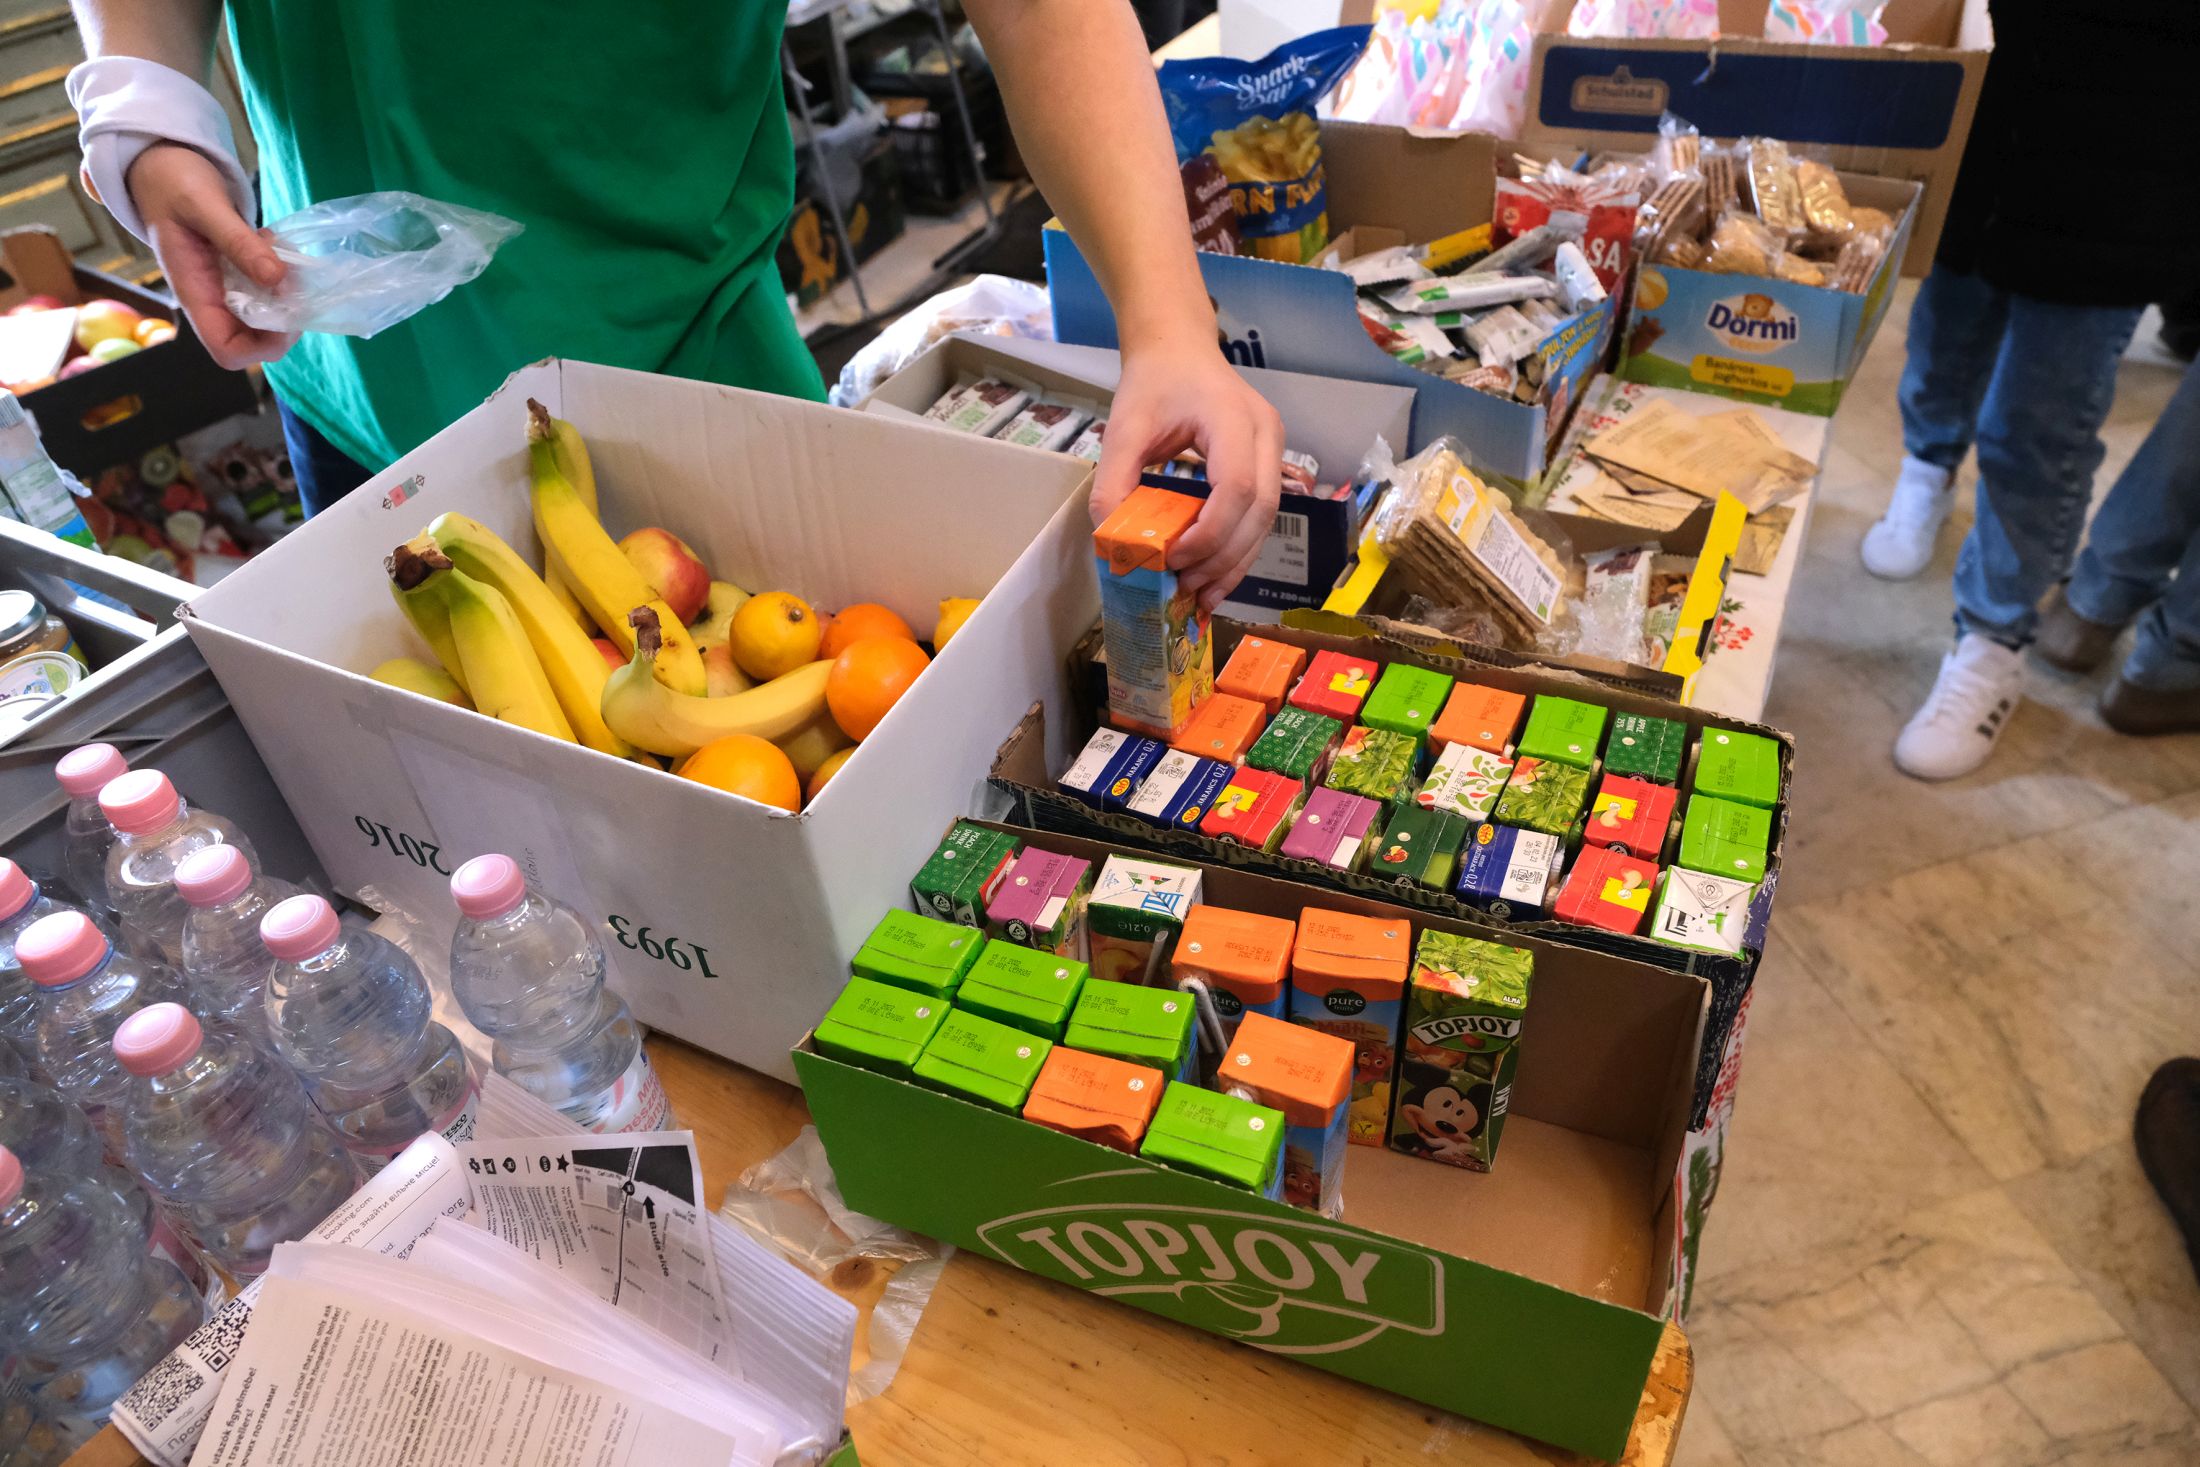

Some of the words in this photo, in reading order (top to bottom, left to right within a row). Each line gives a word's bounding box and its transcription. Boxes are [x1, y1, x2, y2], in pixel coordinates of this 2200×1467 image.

[1708, 303, 1796, 339] Dormi
[1127, 752, 1148, 778] NARANCS
[354, 815, 451, 877] 2016
[948, 829, 961, 841] 25%
[955, 828, 973, 845] DRINK
[964, 832, 981, 849] PEACH
[607, 914, 719, 979] 1993
[1328, 995, 1364, 1009] pure
[1503, 995, 1522, 1005] ALMA
[1421, 1015, 1514, 1041] TOPJOY
[1491, 1083, 1512, 1117] ALMA
[358, 1200, 391, 1229] знайти
[387, 1177, 417, 1203] вільне
[414, 1154, 441, 1179] місце!
[321, 1195, 375, 1241] booking.com
[650, 1221, 661, 1251] Buda
[658, 1254, 669, 1277] side
[1016, 1220, 1381, 1304] TOPJOY
[312, 1338, 330, 1376] Hungarian
[212, 1430, 230, 1465] utazók
[226, 1367, 257, 1429] figyelmébe!
[228, 1409, 253, 1460] travellers!
